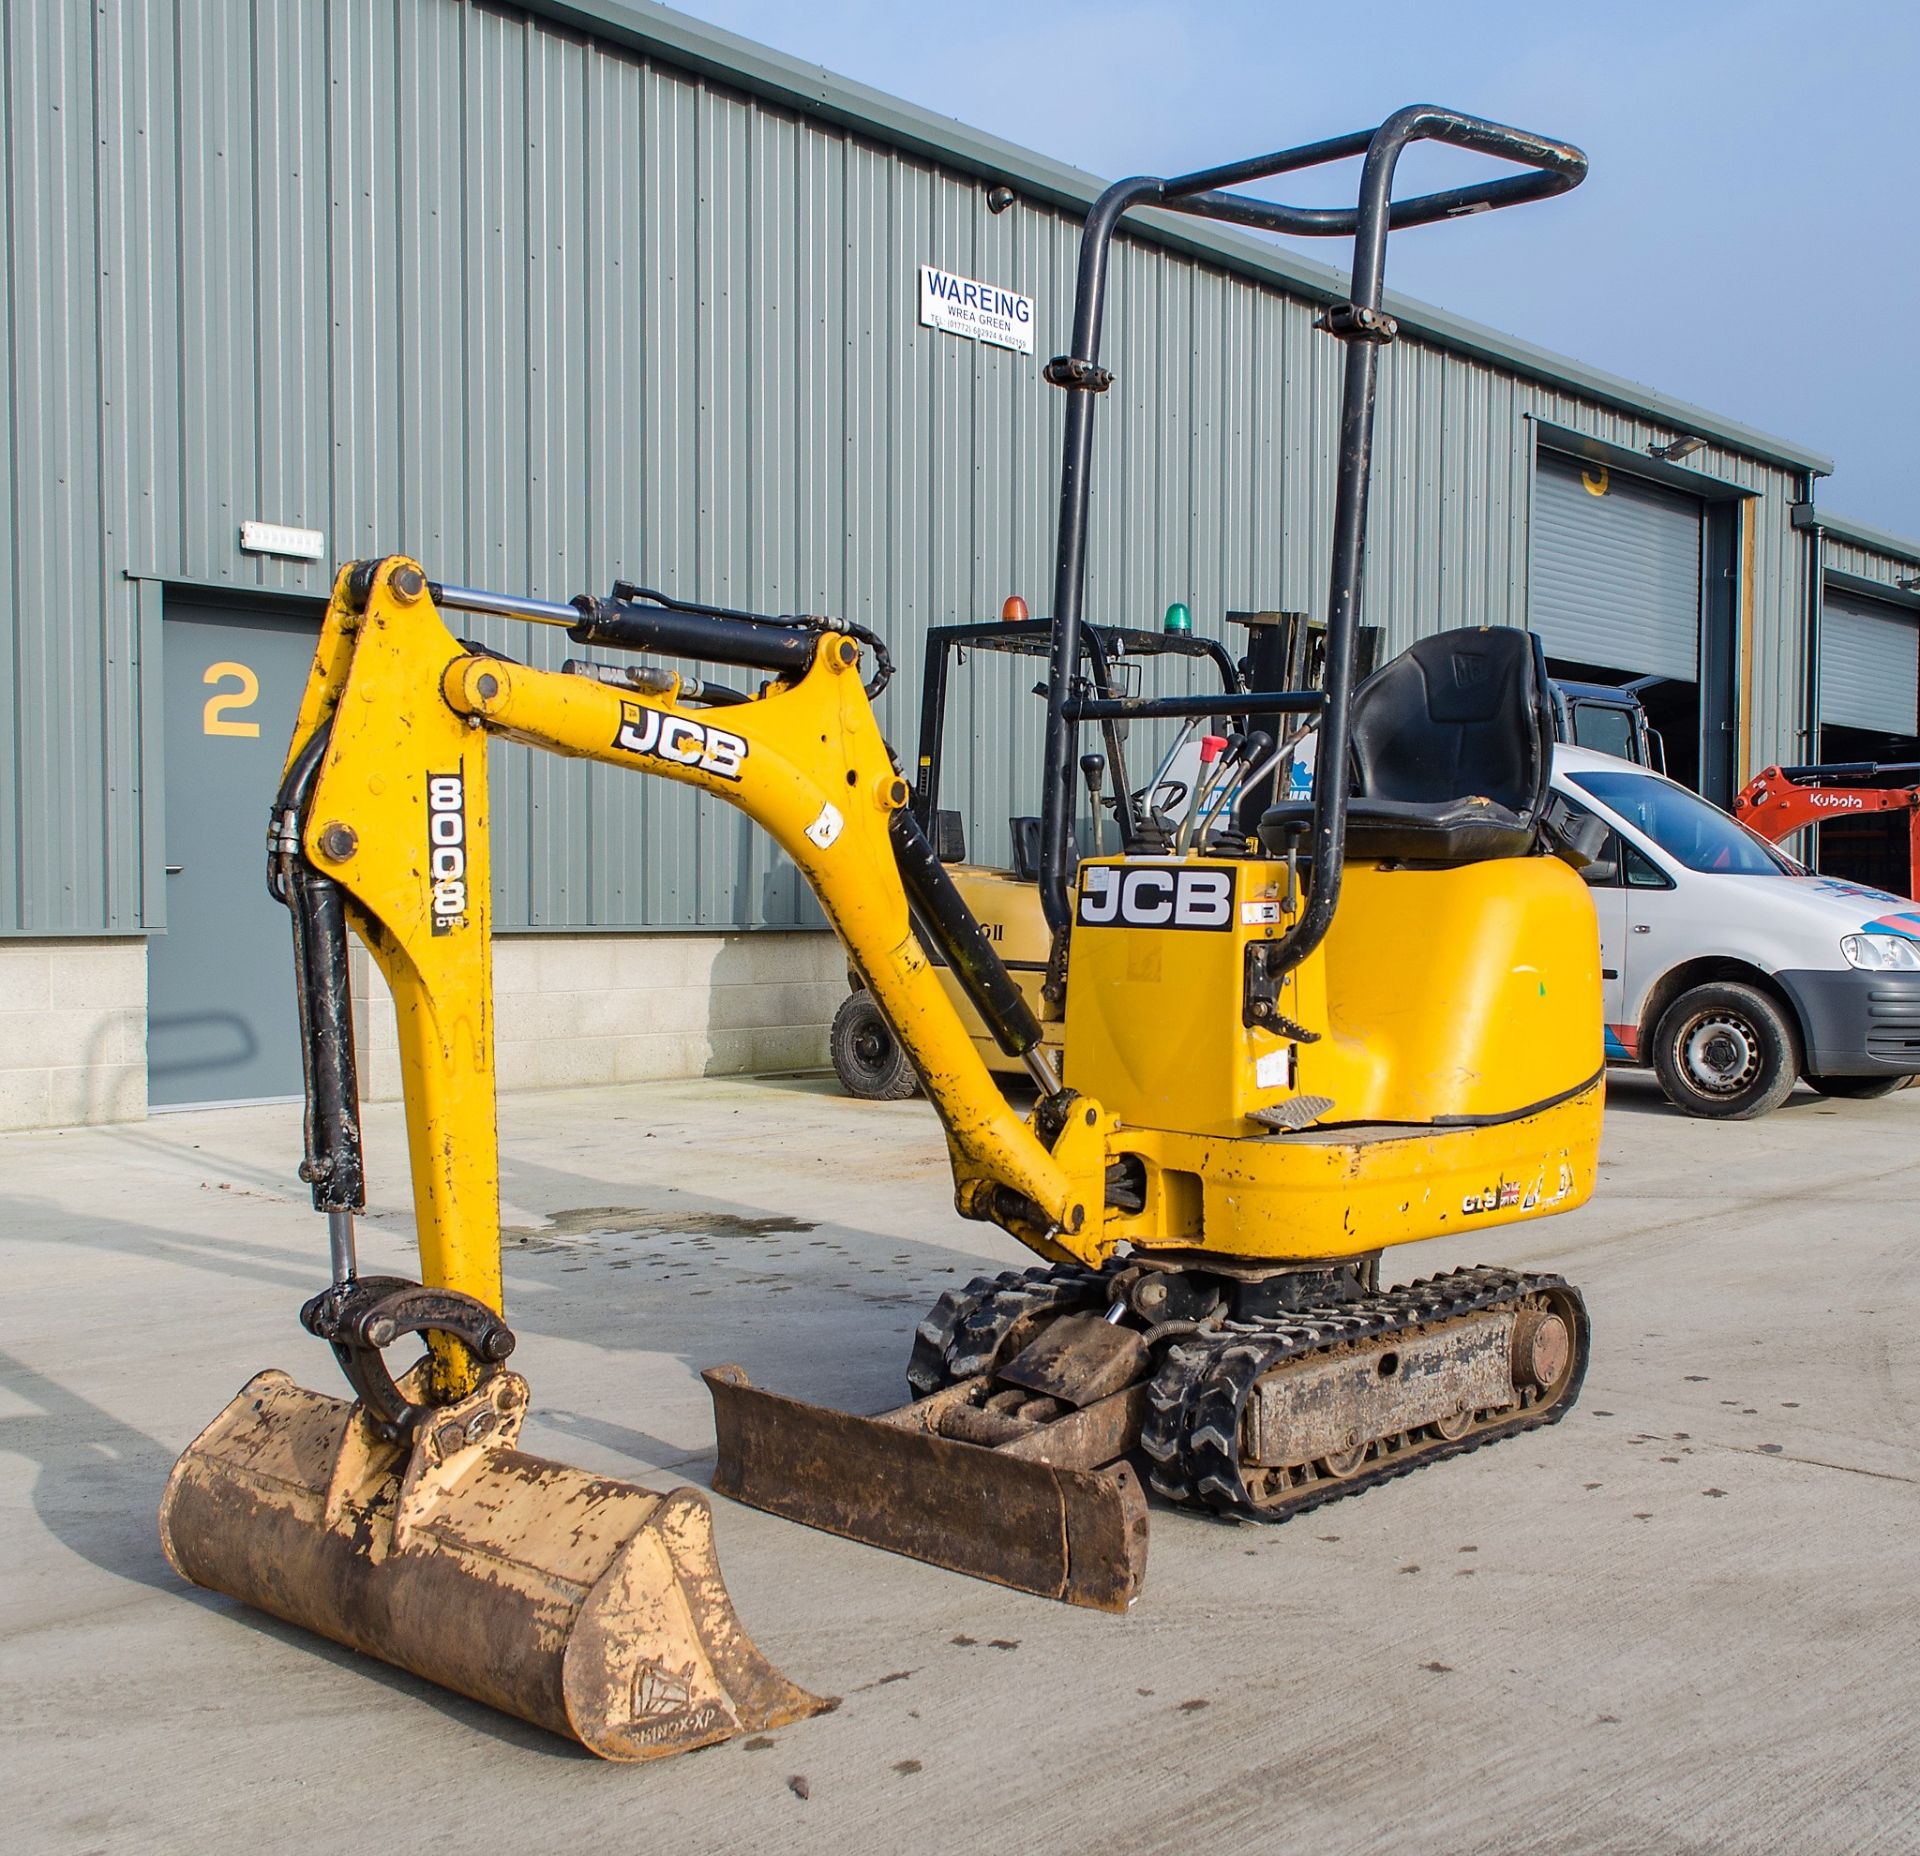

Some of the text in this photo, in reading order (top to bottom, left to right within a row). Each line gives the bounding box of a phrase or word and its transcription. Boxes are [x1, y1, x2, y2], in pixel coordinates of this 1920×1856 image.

[927, 270, 1030, 323] WAREING
[947, 305, 1011, 332] WREA GREEN
[203, 661, 260, 738] 2
[619, 710, 747, 777] JCB
[1810, 793, 1863, 809] Kubota
[430, 777, 466, 915] 8008
[1080, 869, 1231, 926] JCB
